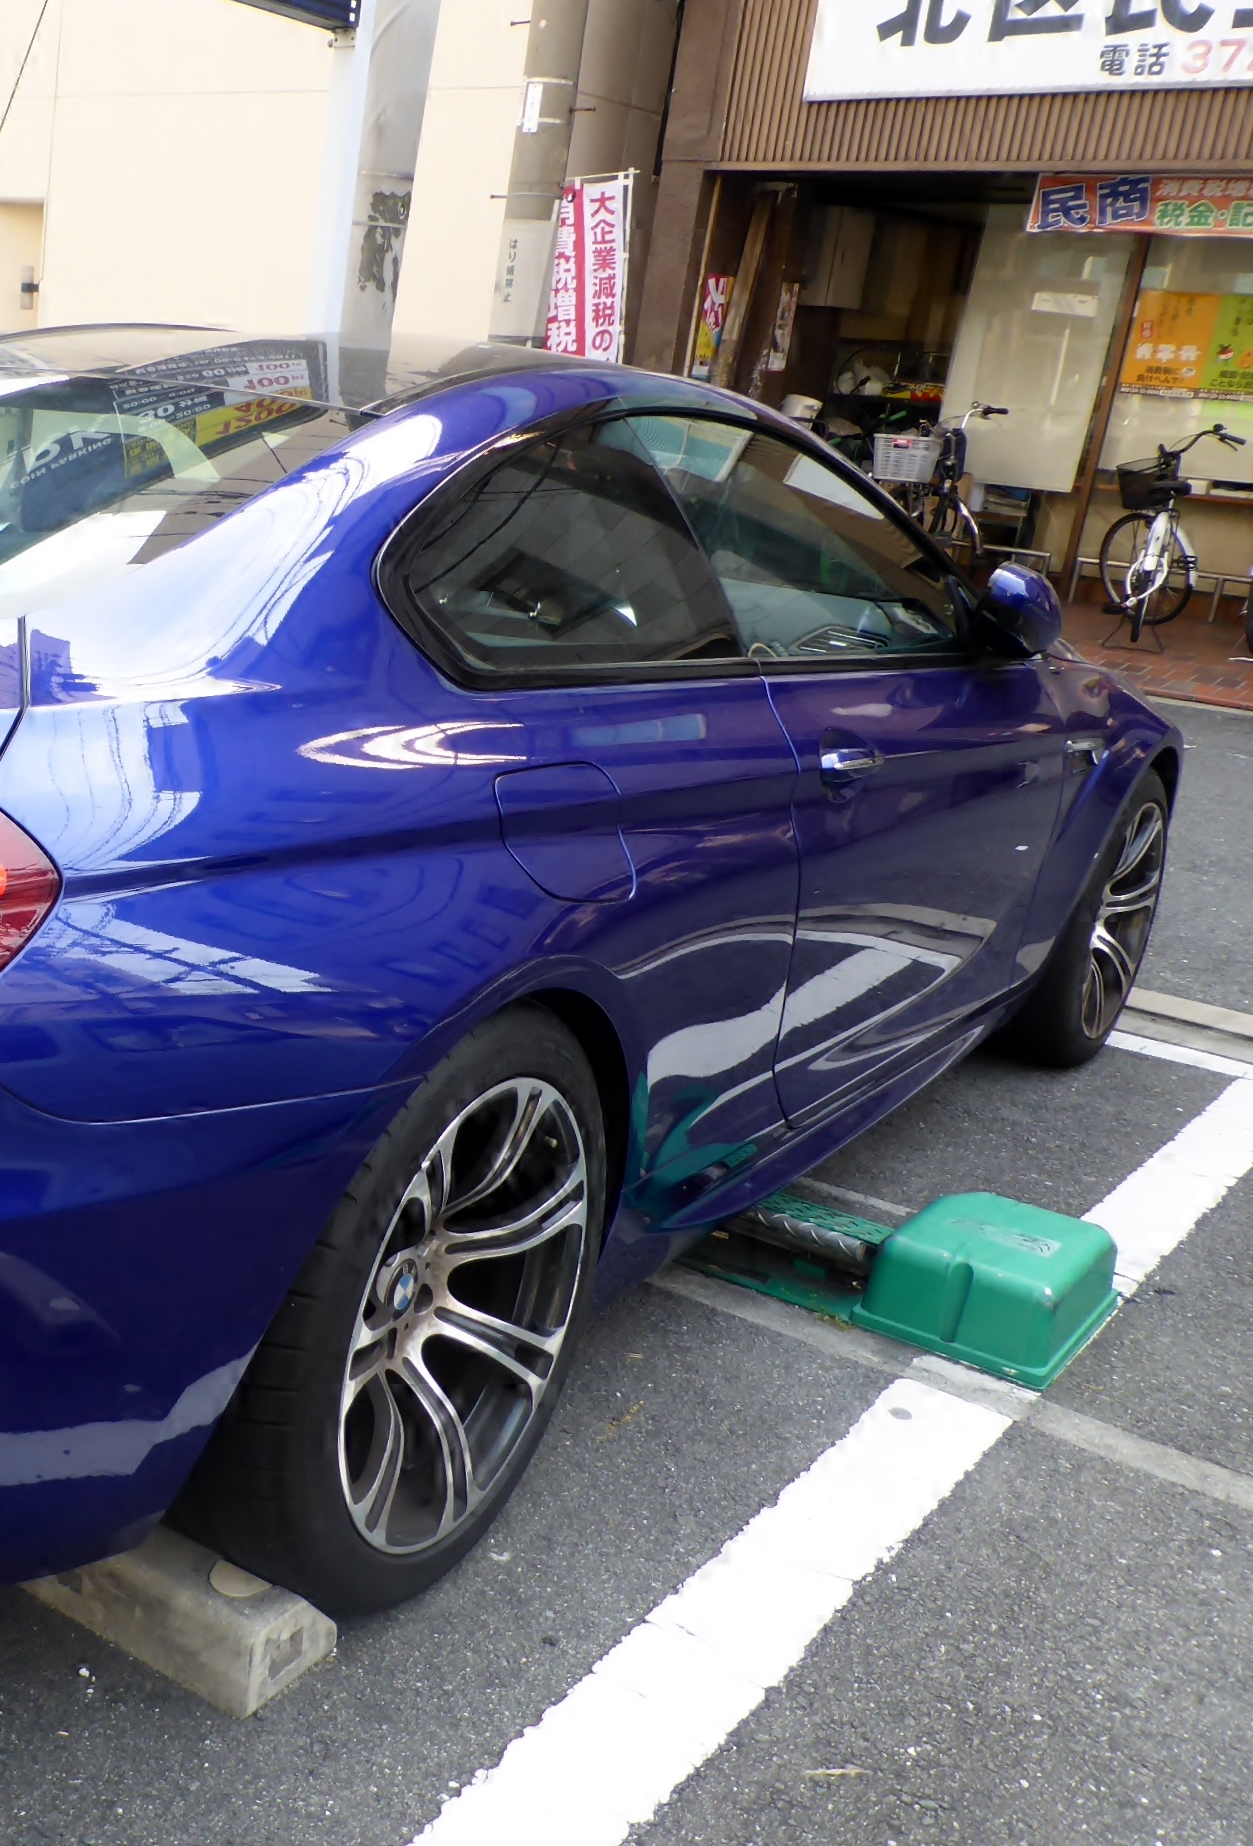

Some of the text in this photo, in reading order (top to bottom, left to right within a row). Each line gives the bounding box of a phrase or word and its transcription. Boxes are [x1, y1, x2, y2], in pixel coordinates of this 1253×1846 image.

[1099, 37, 1253, 76] 電話 37
[1037, 176, 1152, 232] 民商
[1156, 179, 1253, 197] 消費税増
[503, 238, 518, 303] はり紙禁止
[590, 191, 617, 362] 大企業減税の
